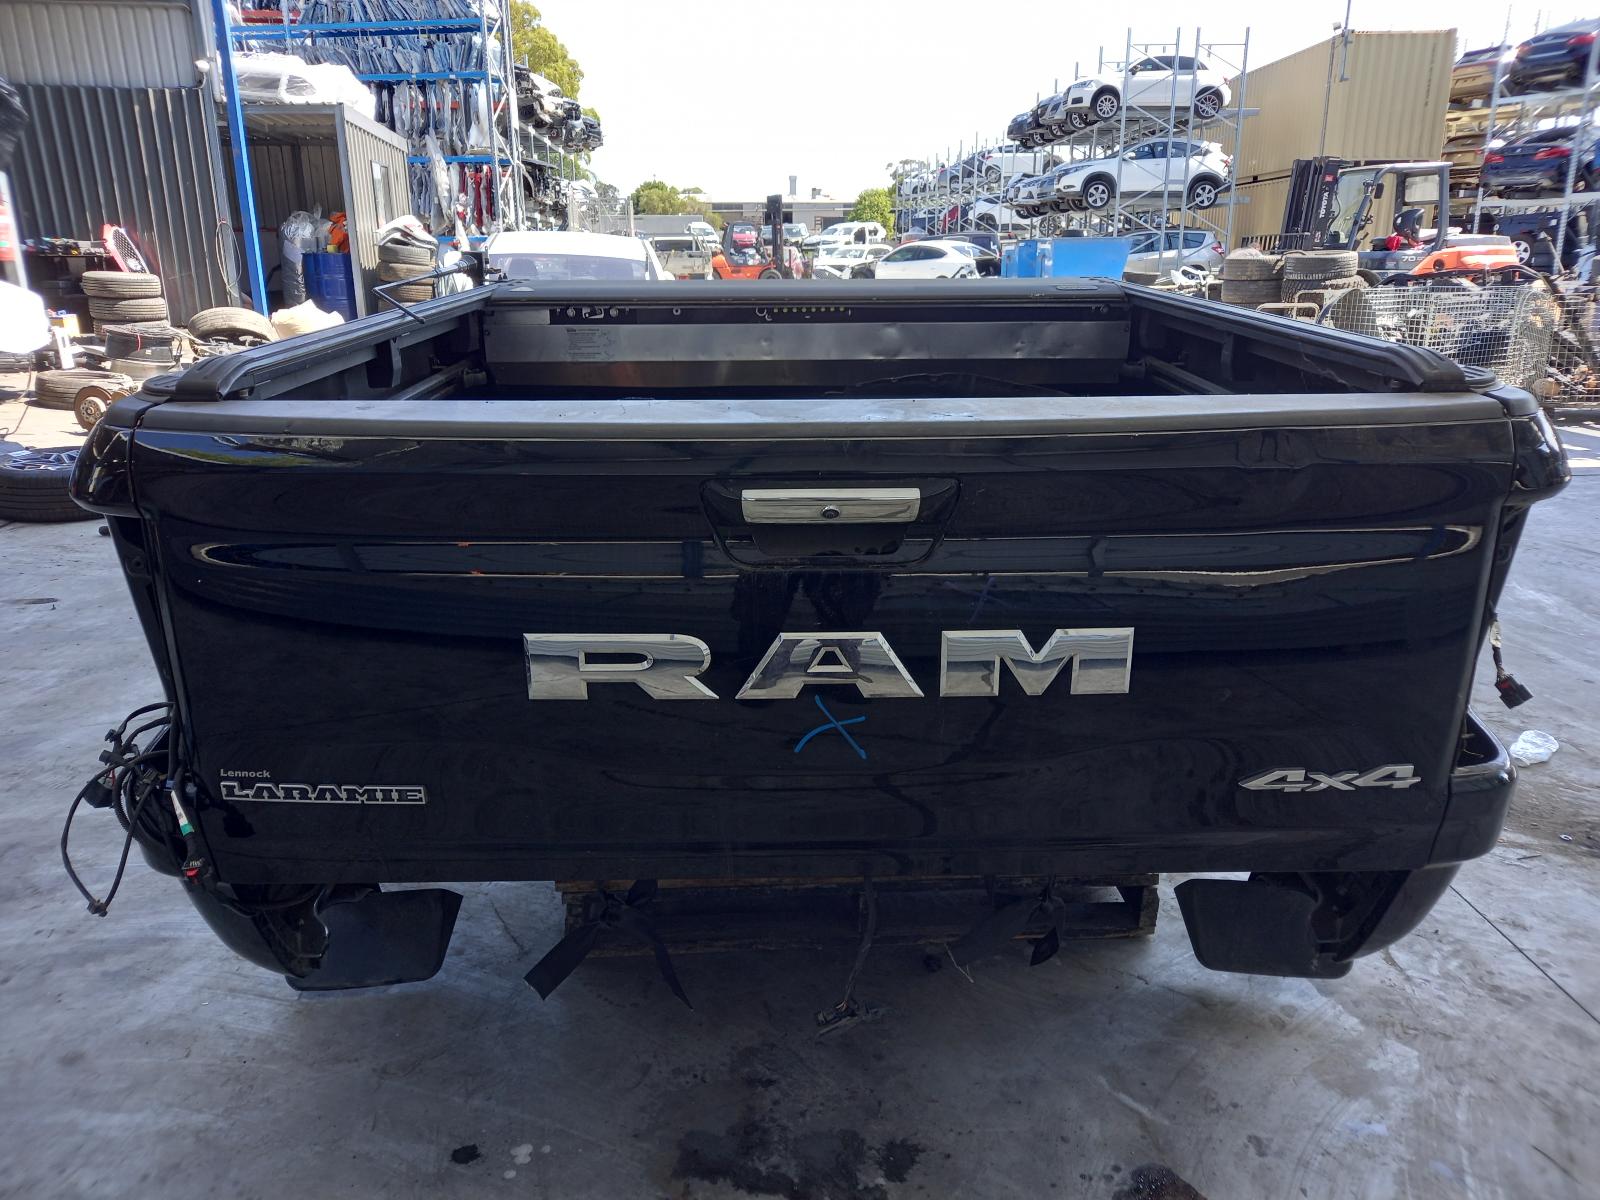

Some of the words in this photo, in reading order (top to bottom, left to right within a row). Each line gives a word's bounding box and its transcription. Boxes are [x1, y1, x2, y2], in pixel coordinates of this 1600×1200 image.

[1319, 191, 1330, 218] TOYOTA
[523, 627, 1135, 700] RAM
[220, 768, 271, 778] Lennock
[220, 781, 426, 804] LARAMIE
